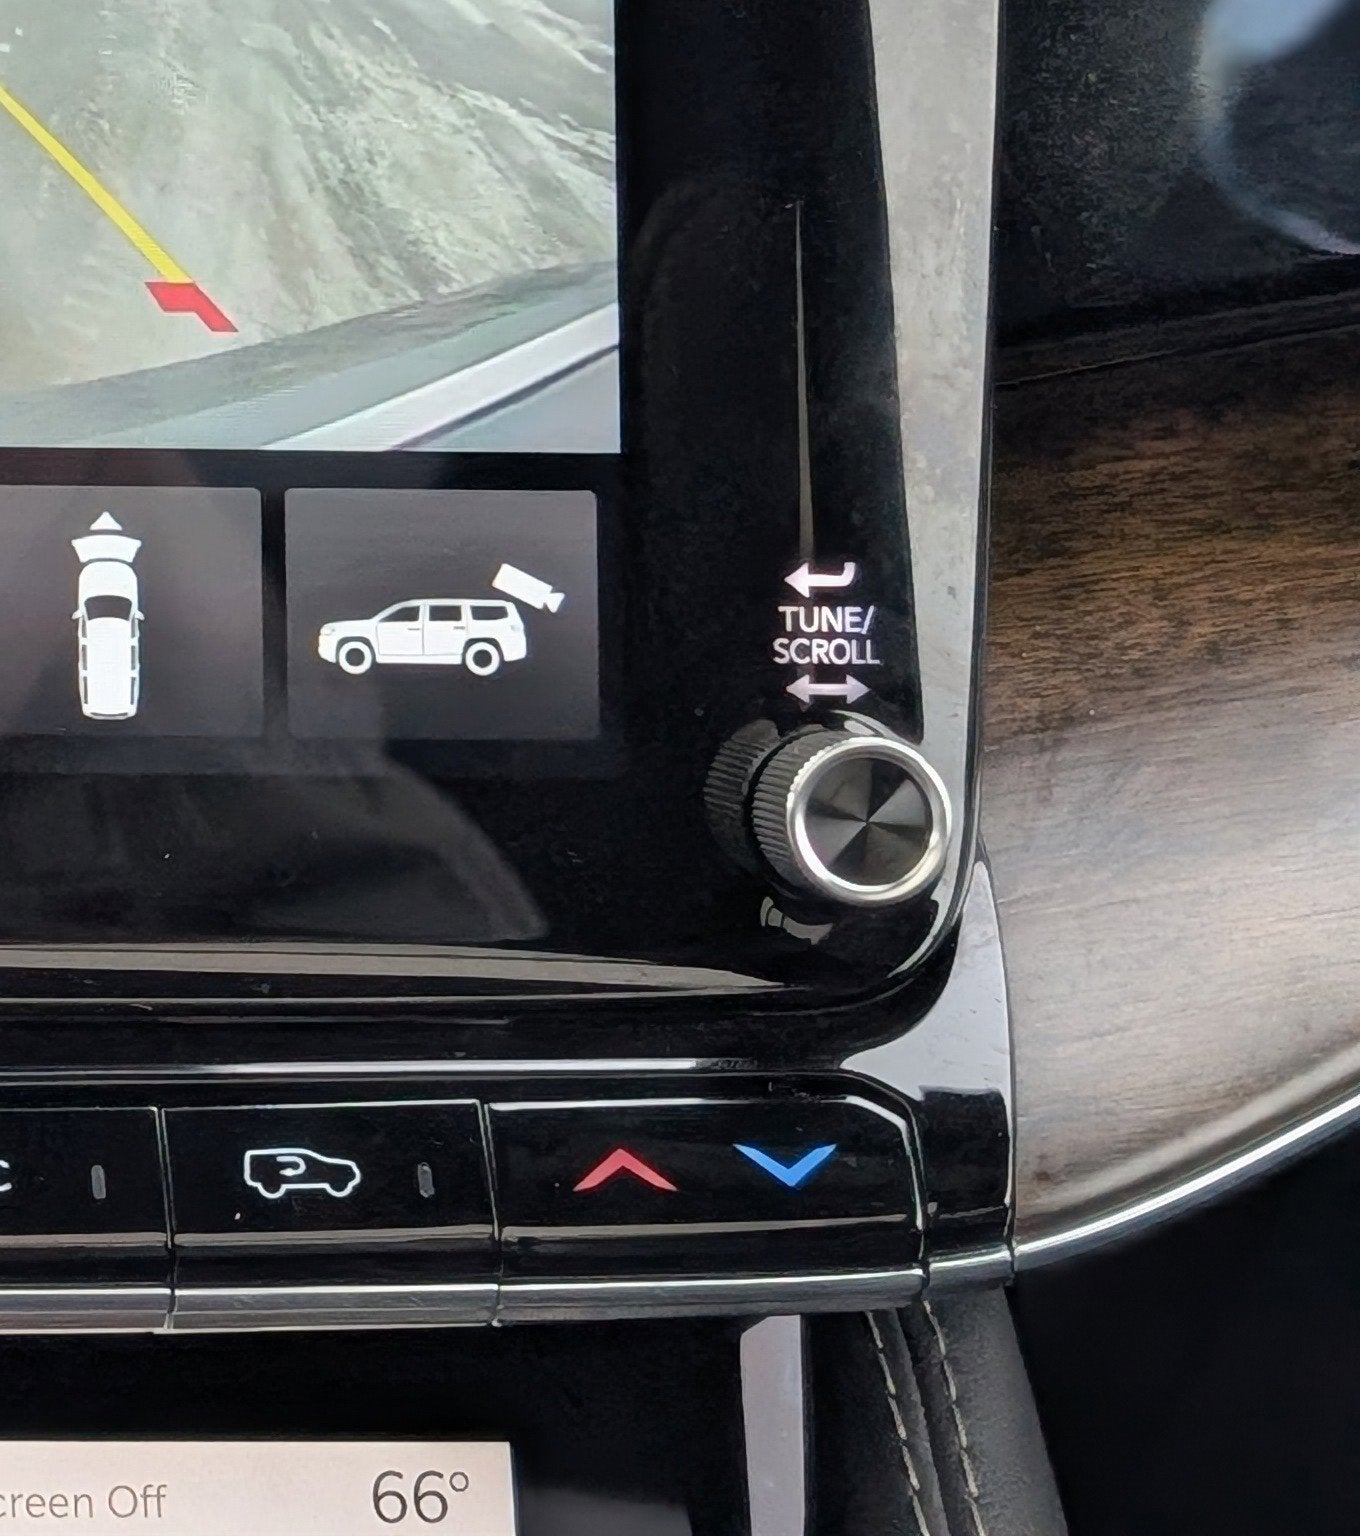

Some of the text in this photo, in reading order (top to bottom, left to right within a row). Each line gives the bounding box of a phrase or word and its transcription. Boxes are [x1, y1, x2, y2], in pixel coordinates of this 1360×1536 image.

[777, 605, 875, 635] TUNE/
[772, 637, 880, 665] SCROLL
[108, 1483, 168, 1519] Off
